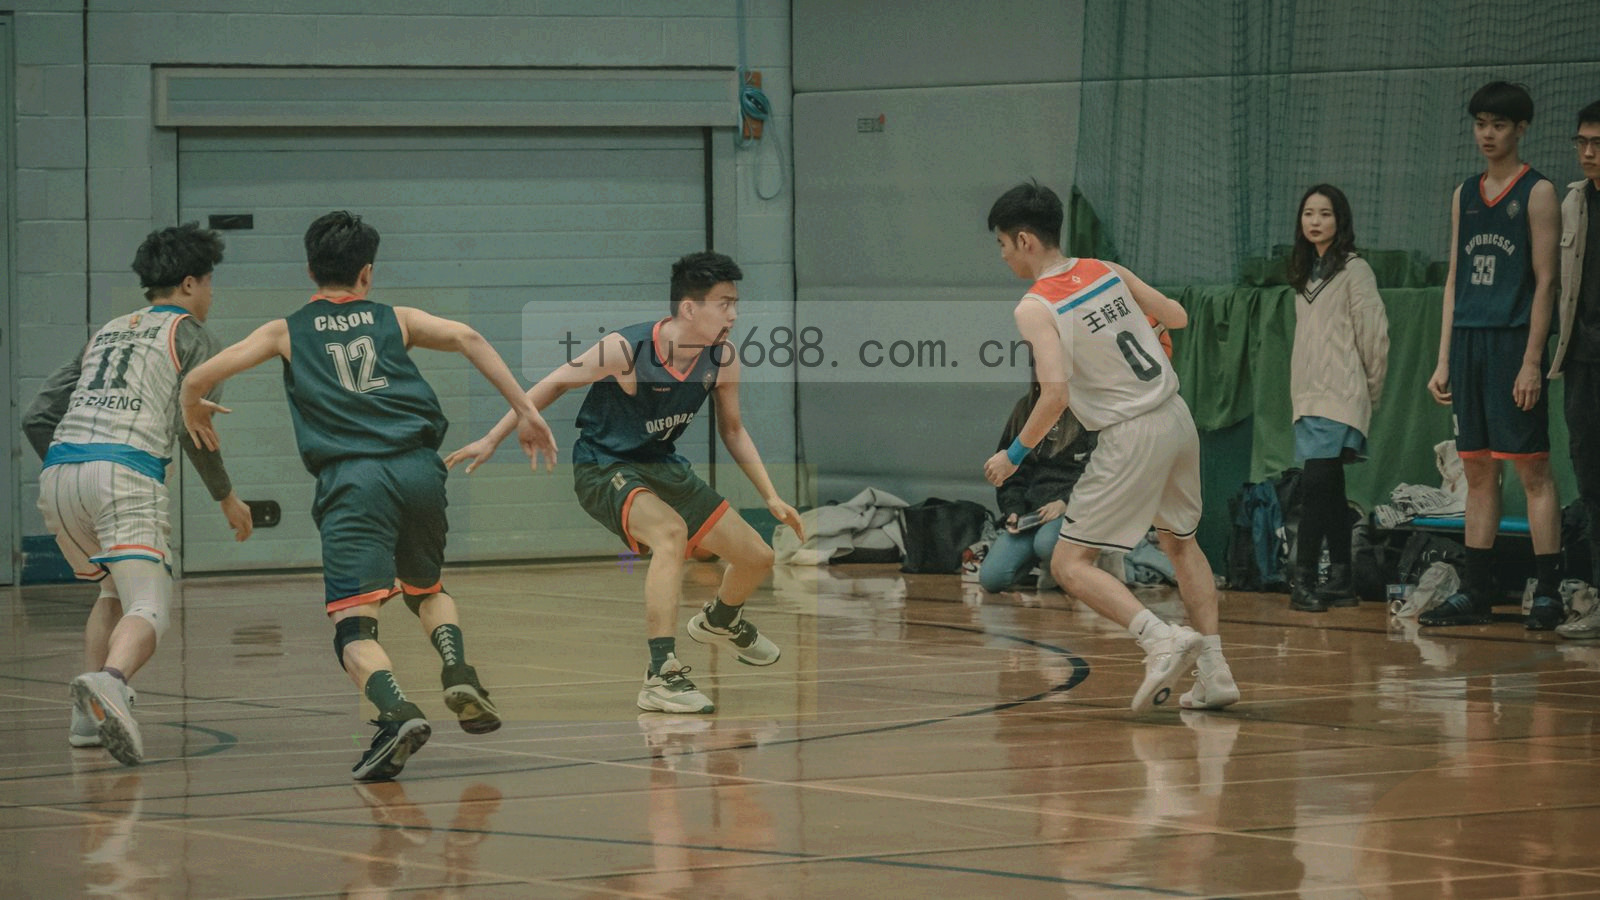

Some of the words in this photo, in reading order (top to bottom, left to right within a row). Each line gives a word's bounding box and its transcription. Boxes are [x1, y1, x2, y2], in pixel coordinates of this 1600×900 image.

[1471, 254, 1496, 286] 33
[314, 311, 374, 332] CASON
[87, 343, 135, 390] 11
[325, 336, 389, 394] 12
[1116, 330, 1162, 382] 0
